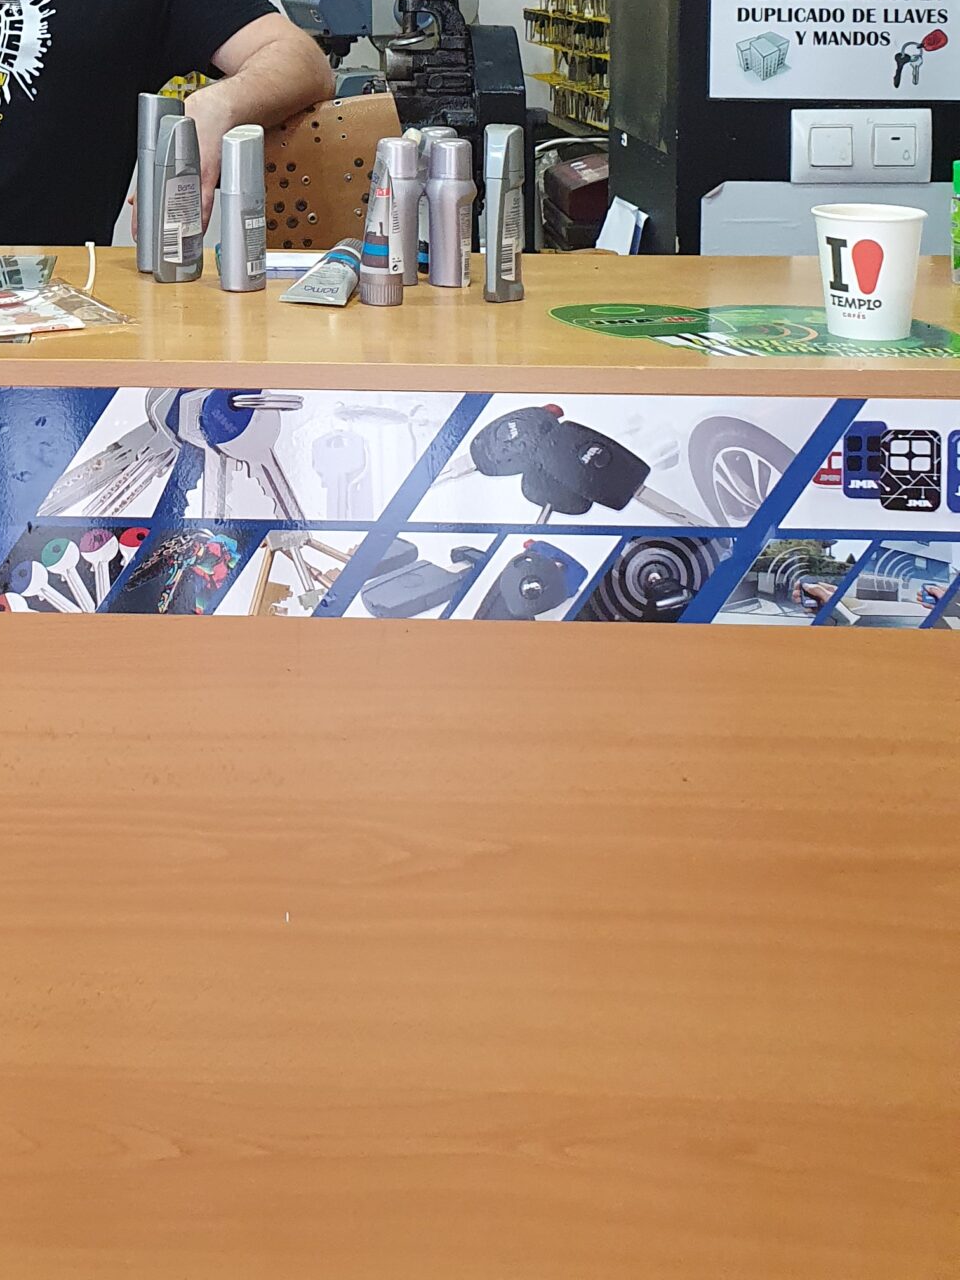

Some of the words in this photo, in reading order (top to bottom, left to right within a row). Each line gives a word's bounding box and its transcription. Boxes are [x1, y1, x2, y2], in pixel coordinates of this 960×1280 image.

[737, 7, 845, 23] DUPLICADO
[852, 8, 877, 24] DE
[883, 8, 949, 24] LLAVES
[795, 30, 807, 46] Y
[813, 30, 891, 47] MANDOS
[826, 236, 848, 292] I
[830, 293, 882, 311] TEMPLO
